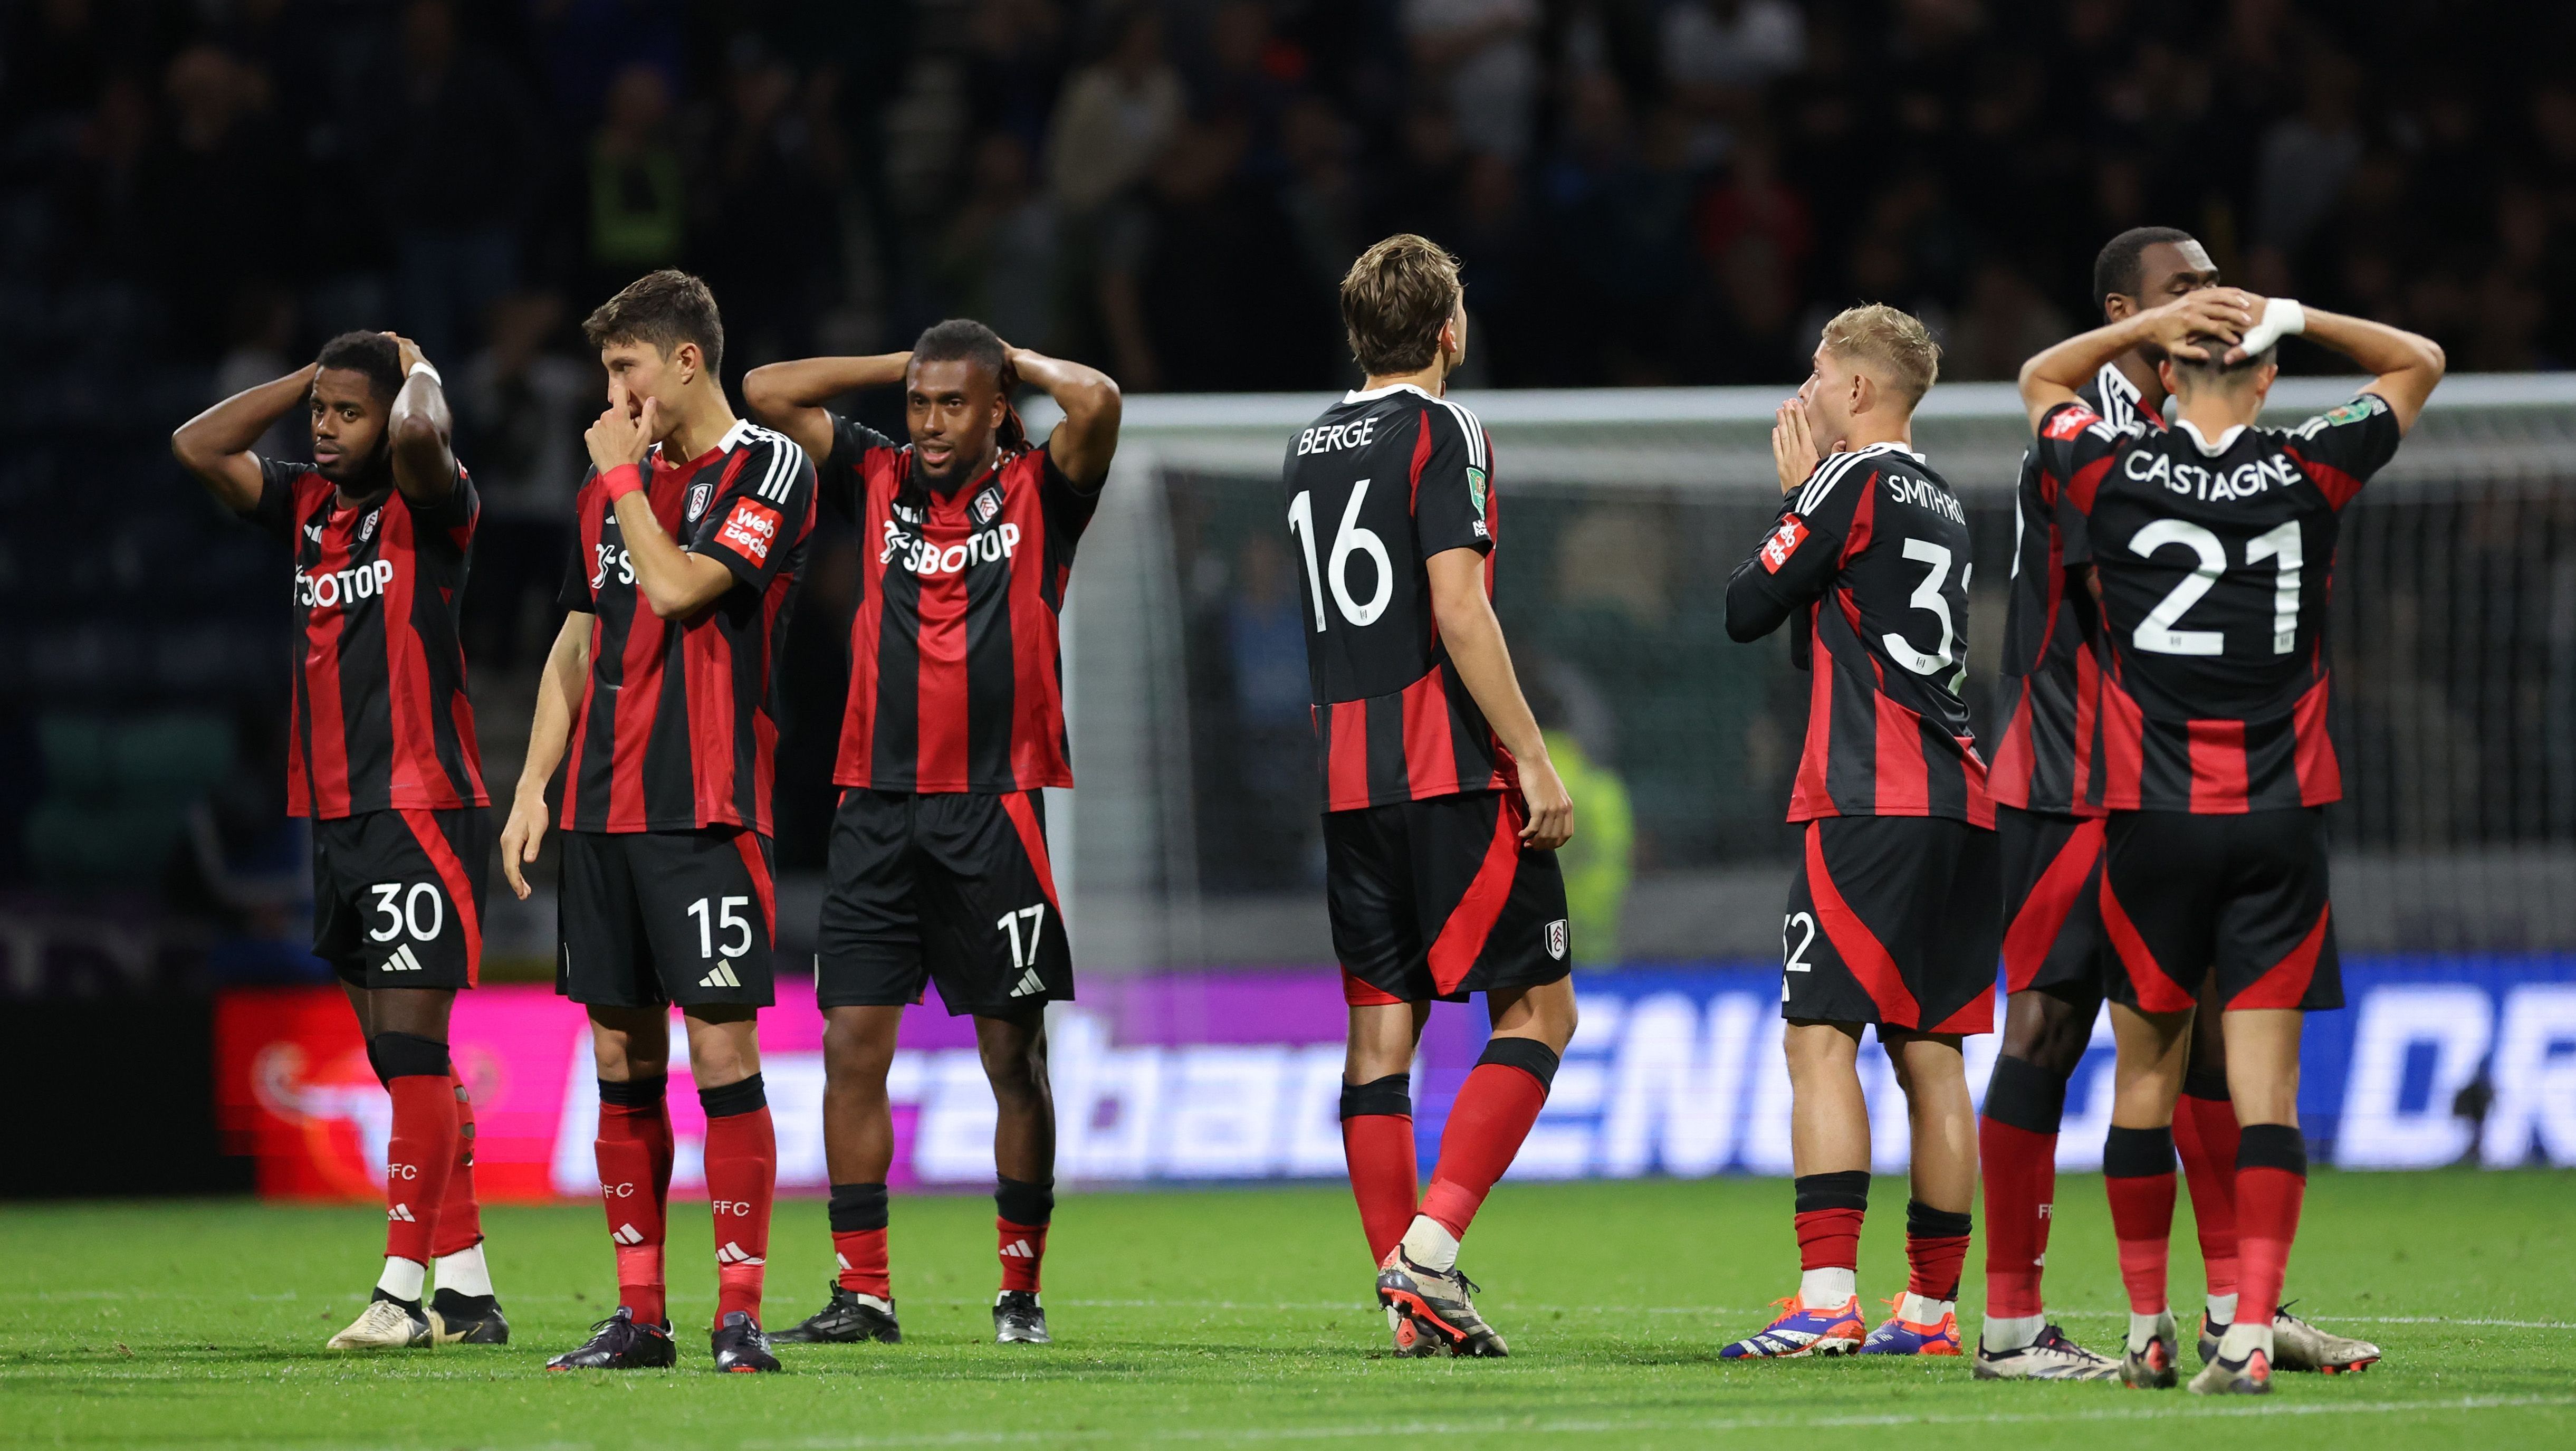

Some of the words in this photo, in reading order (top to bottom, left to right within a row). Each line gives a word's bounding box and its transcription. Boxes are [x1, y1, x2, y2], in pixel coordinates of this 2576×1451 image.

[1297, 417, 1378, 456] BERGE
[2125, 449, 2302, 502] CASTAGNE
[724, 520, 768, 558] Beds
[736, 507, 774, 538] Web
[903, 522, 1020, 575] SBOTOP
[1287, 479, 1393, 633] 16
[1767, 538, 1786, 566] eds
[302, 559, 393, 607] OTOP
[2127, 518, 2303, 656] 21
[1882, 537, 1972, 695] 3
[369, 882, 443, 942] 30
[687, 896, 752, 958] 15
[997, 903, 1045, 968] 17
[550, 1003, 1427, 1185] Caaba
[713, 1200, 750, 1216] FFC
